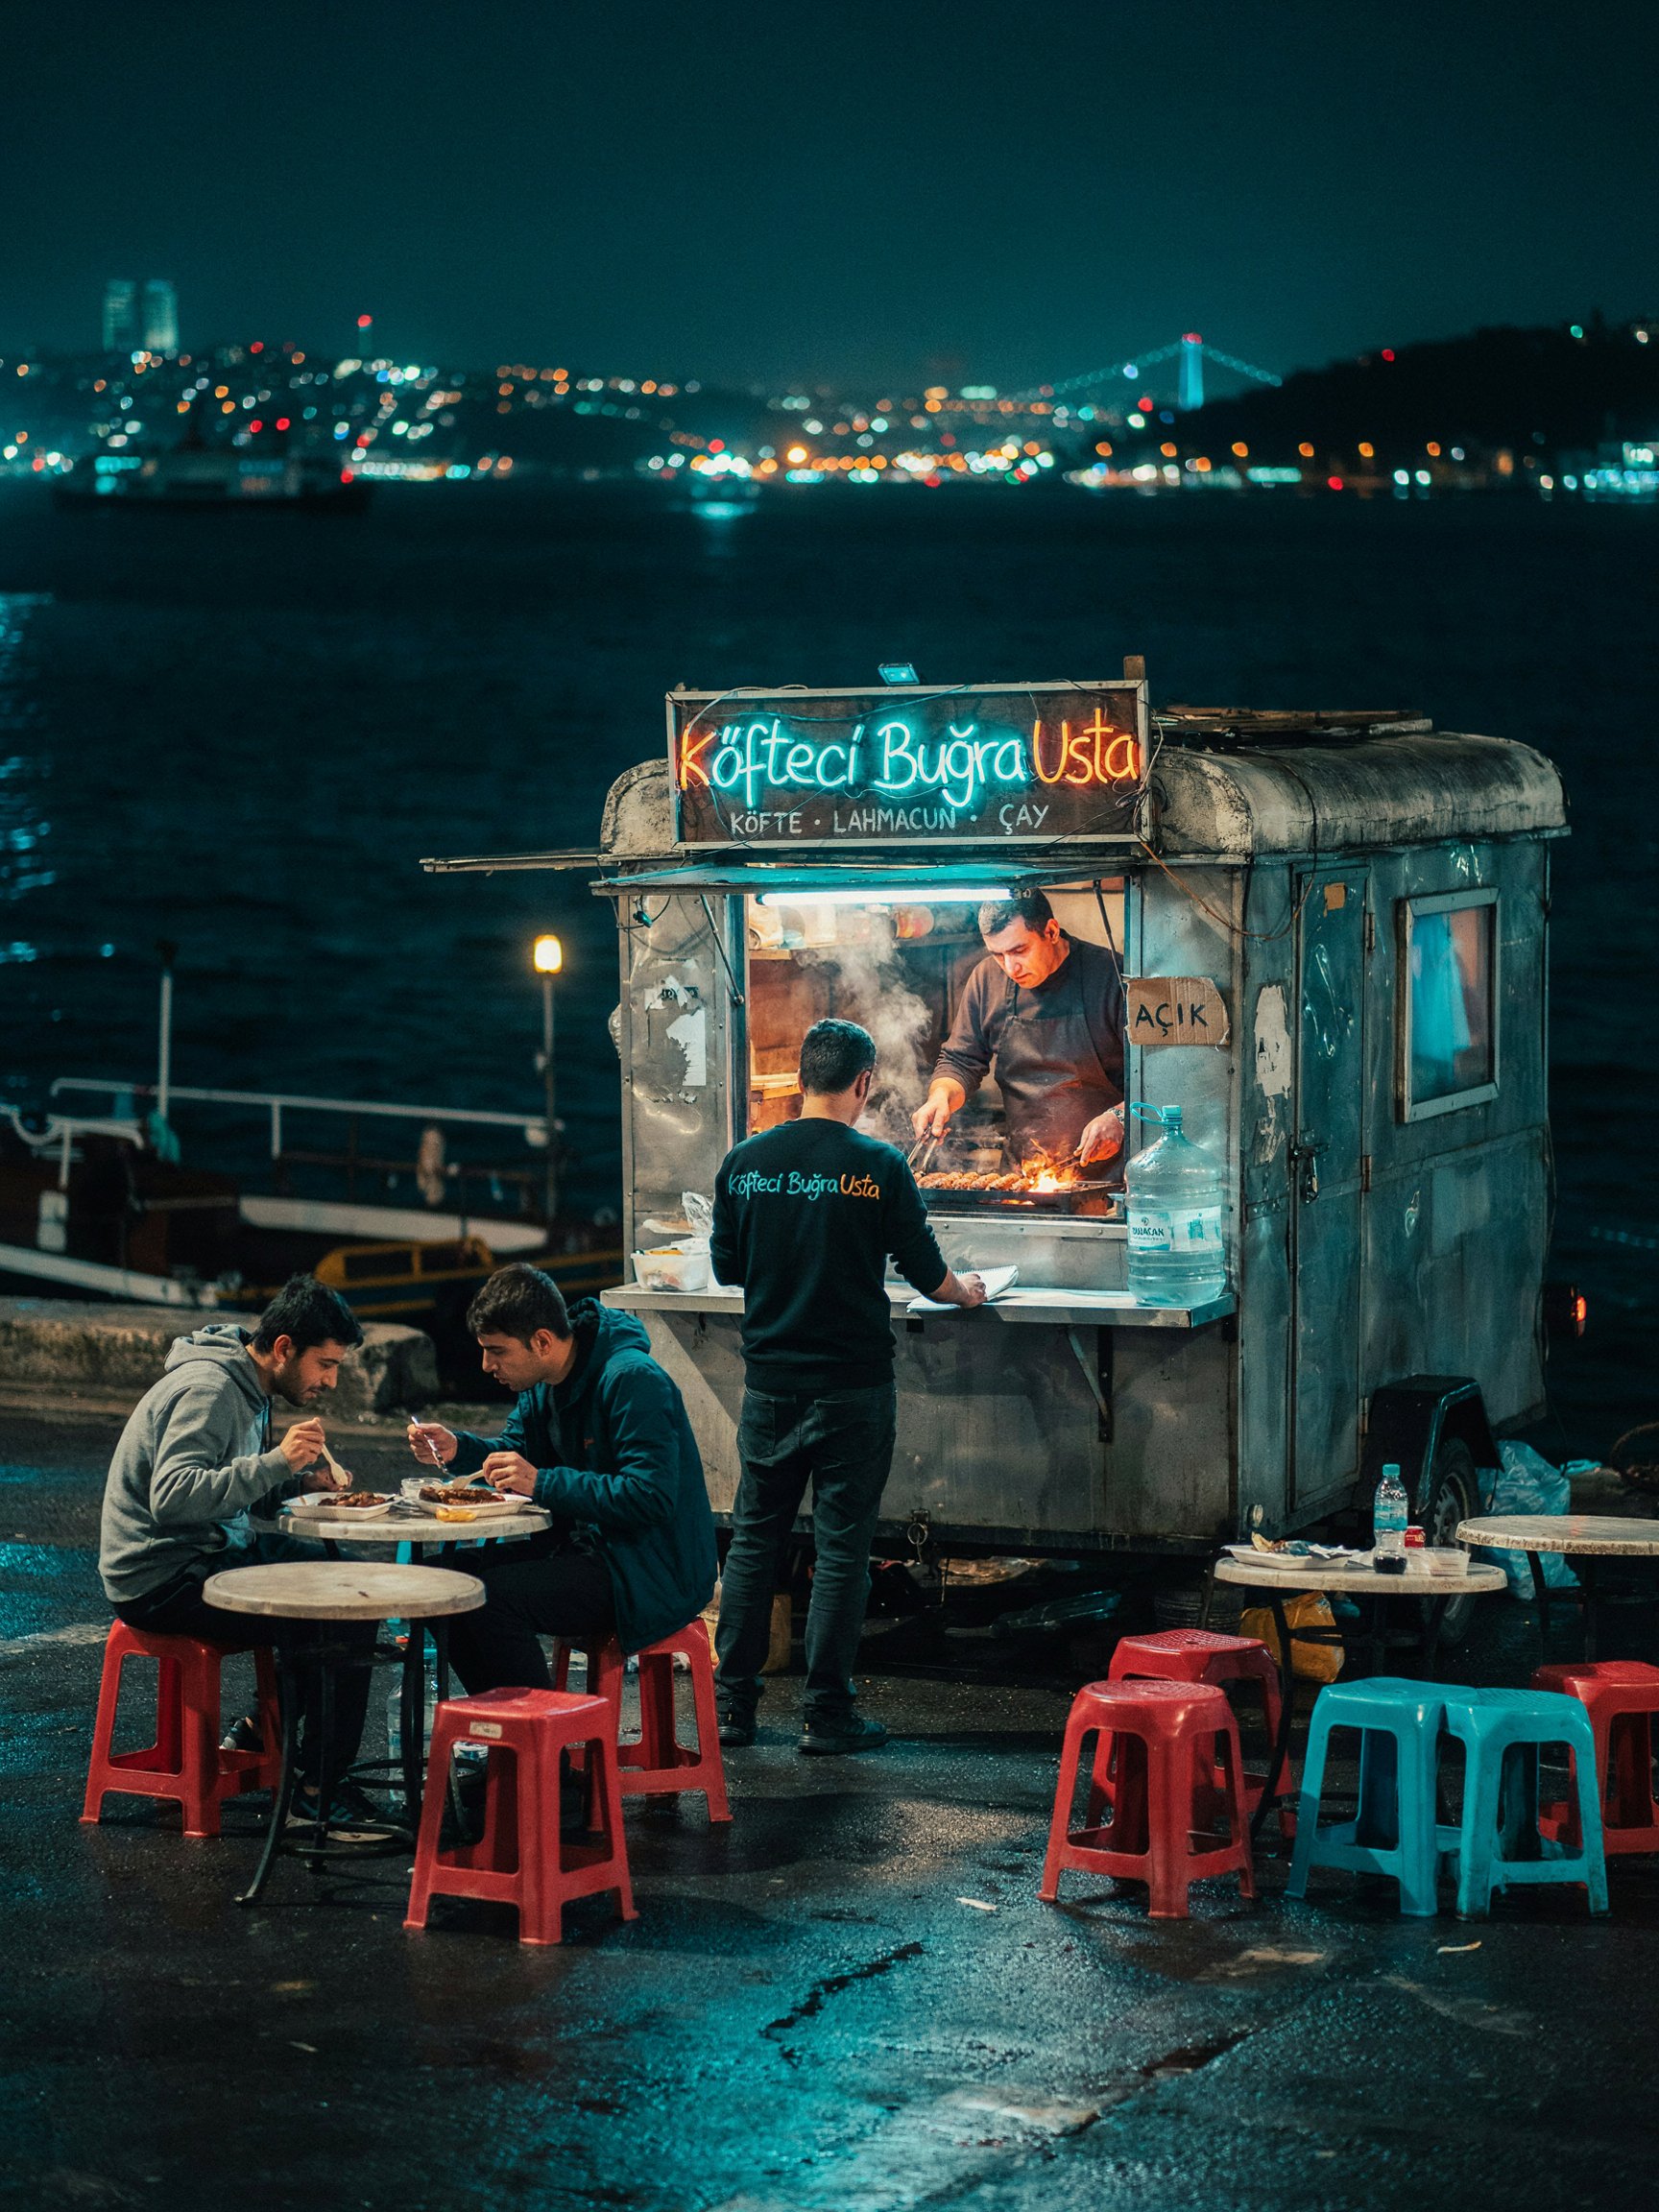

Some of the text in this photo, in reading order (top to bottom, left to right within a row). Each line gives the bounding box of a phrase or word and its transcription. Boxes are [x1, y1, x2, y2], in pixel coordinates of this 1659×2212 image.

[680, 708, 1138, 808] Köfteci Buğra Usta
[730, 804, 1049, 835] KÖFTE LAHMACUN ÇAY
[1135, 1002, 1209, 1037] AÇIK
[786, 1171, 838, 1200] Buğra
[840, 1173, 879, 1200] Usta
